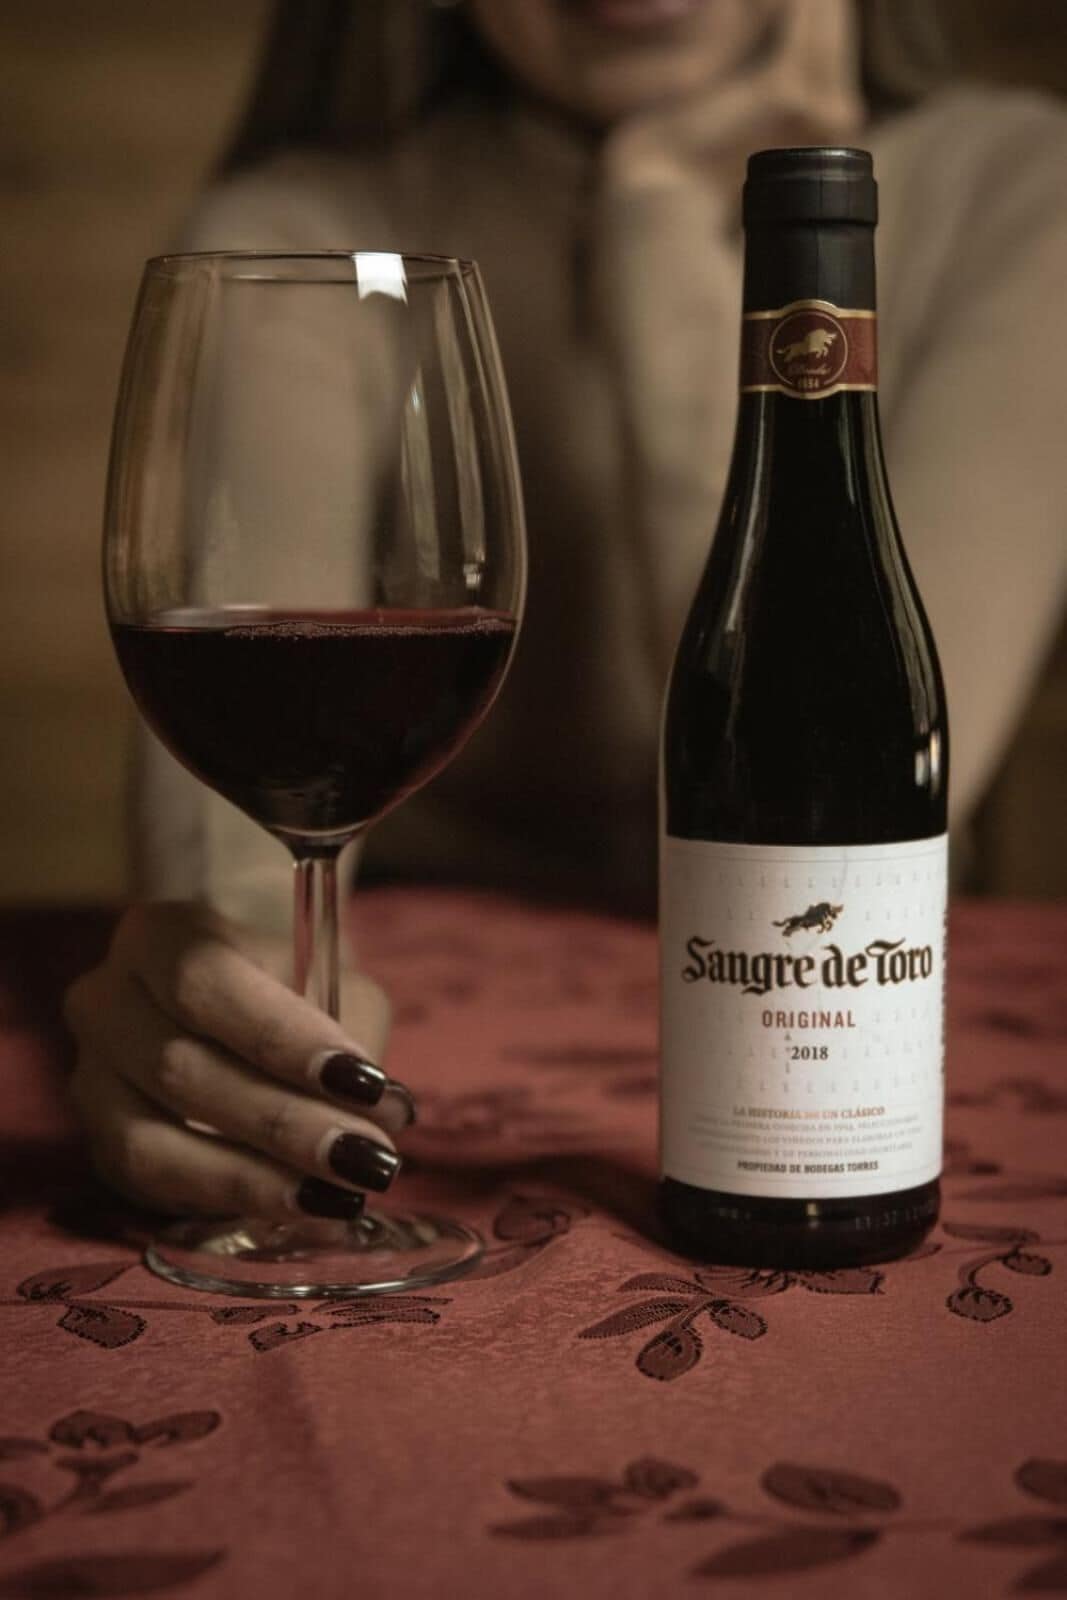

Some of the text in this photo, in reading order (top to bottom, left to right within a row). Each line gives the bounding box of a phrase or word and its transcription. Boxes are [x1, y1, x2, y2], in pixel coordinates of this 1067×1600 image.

[682, 936, 933, 995] Sangre de Toro
[762, 1010, 856, 1028] ORIGINAL
[791, 1046, 829, 1060] 2018
[737, 1160, 879, 1174] PROPIEDAD DE BODEGAS TORRES
